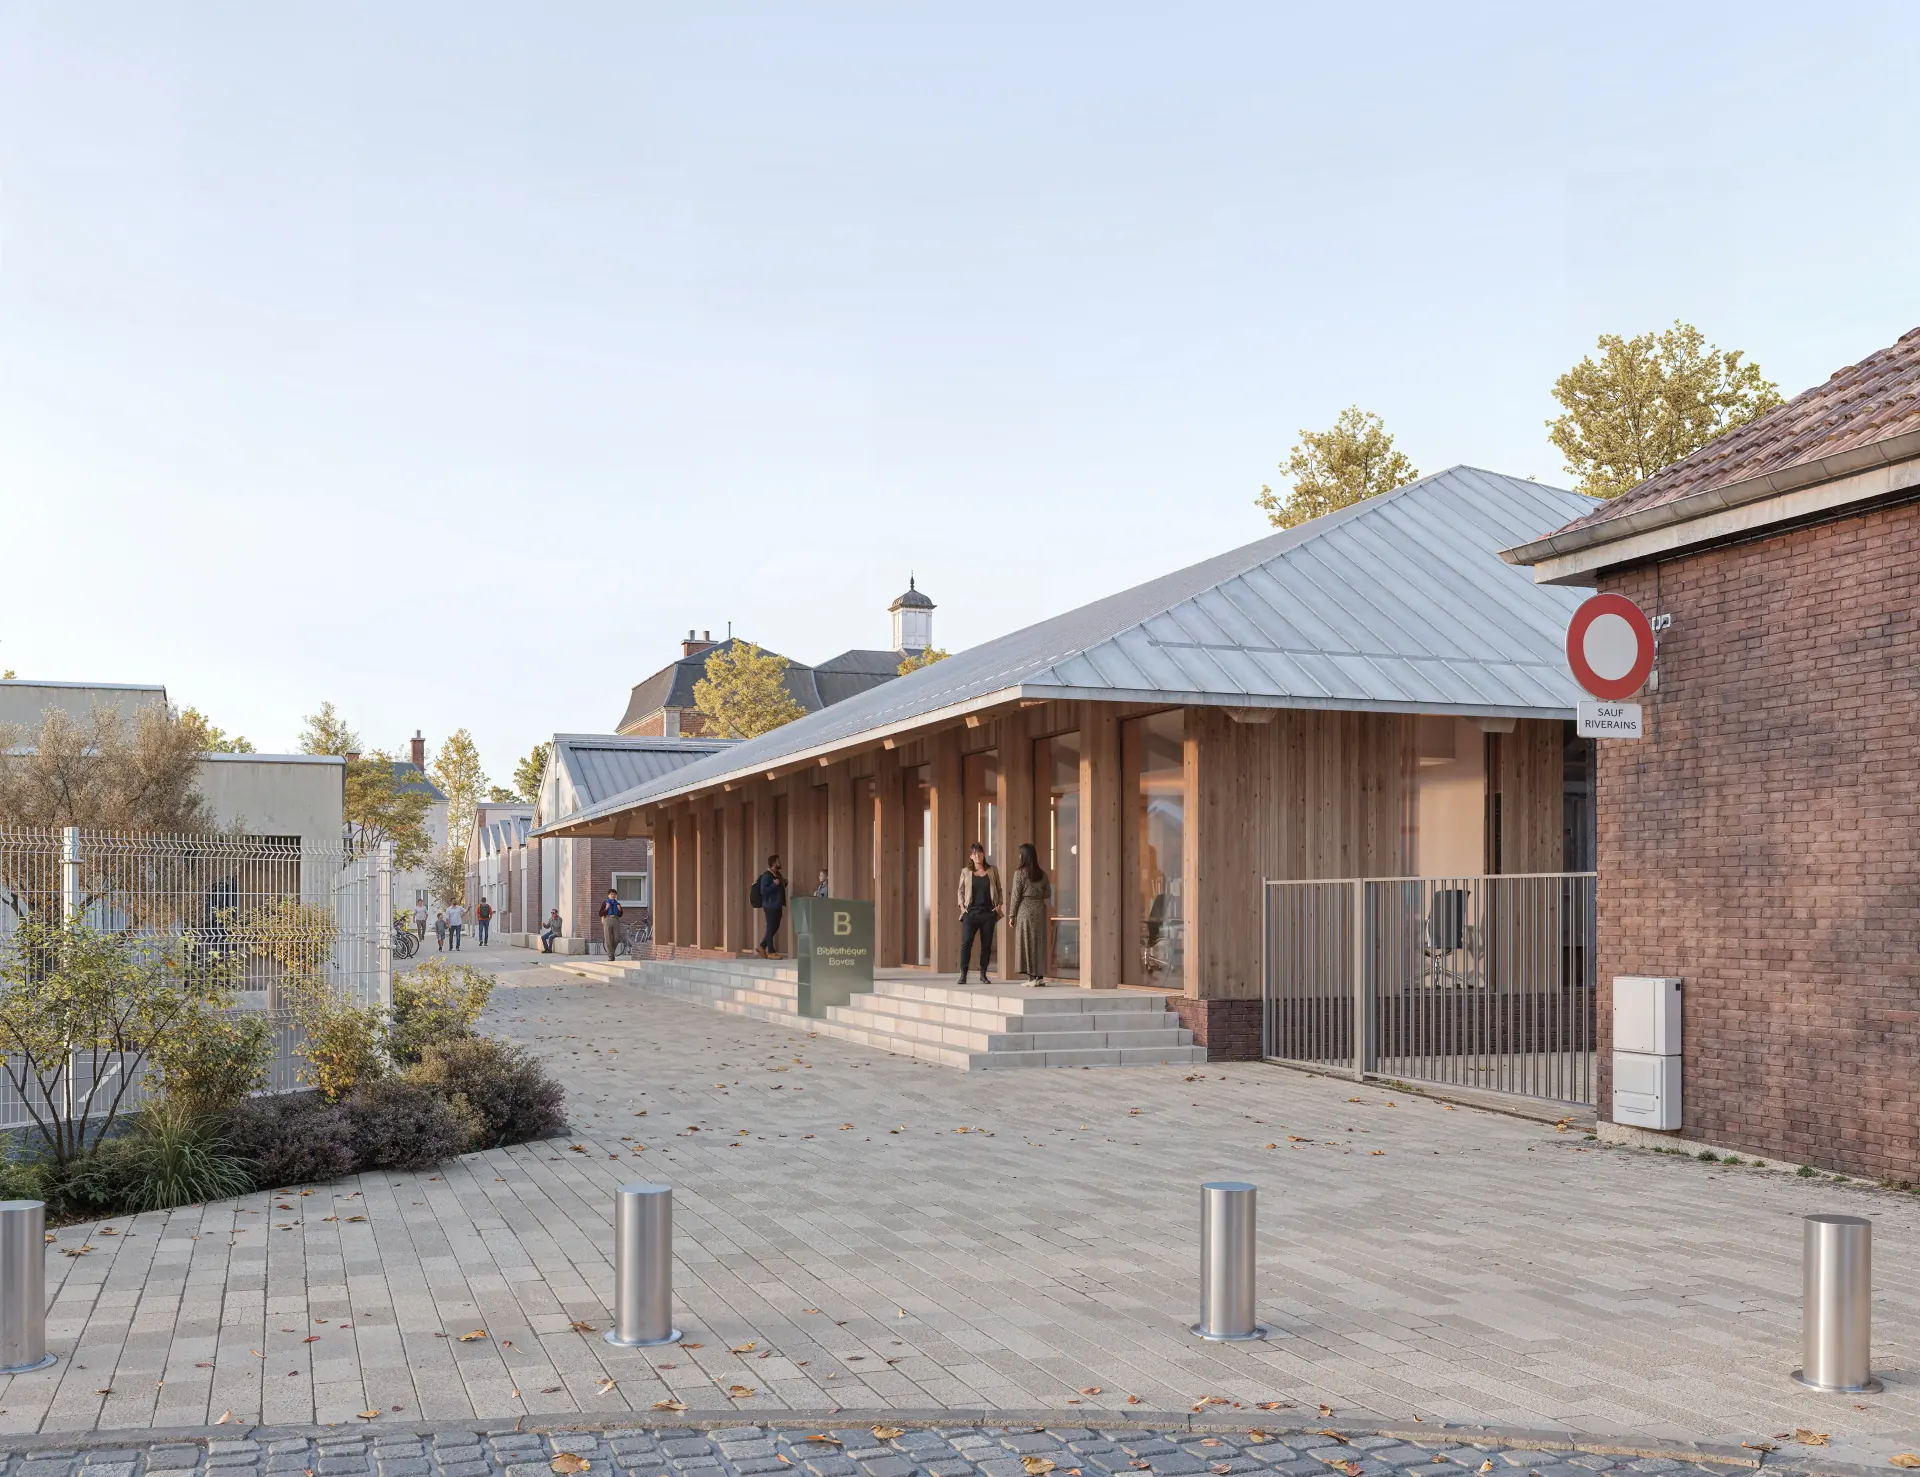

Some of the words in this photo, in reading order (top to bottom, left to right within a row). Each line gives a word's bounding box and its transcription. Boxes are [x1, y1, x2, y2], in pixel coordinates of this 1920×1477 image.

[1597, 708, 1624, 717] SAUF
[1586, 720, 1636, 730] RIVERAINS
[833, 912, 852, 935] B
